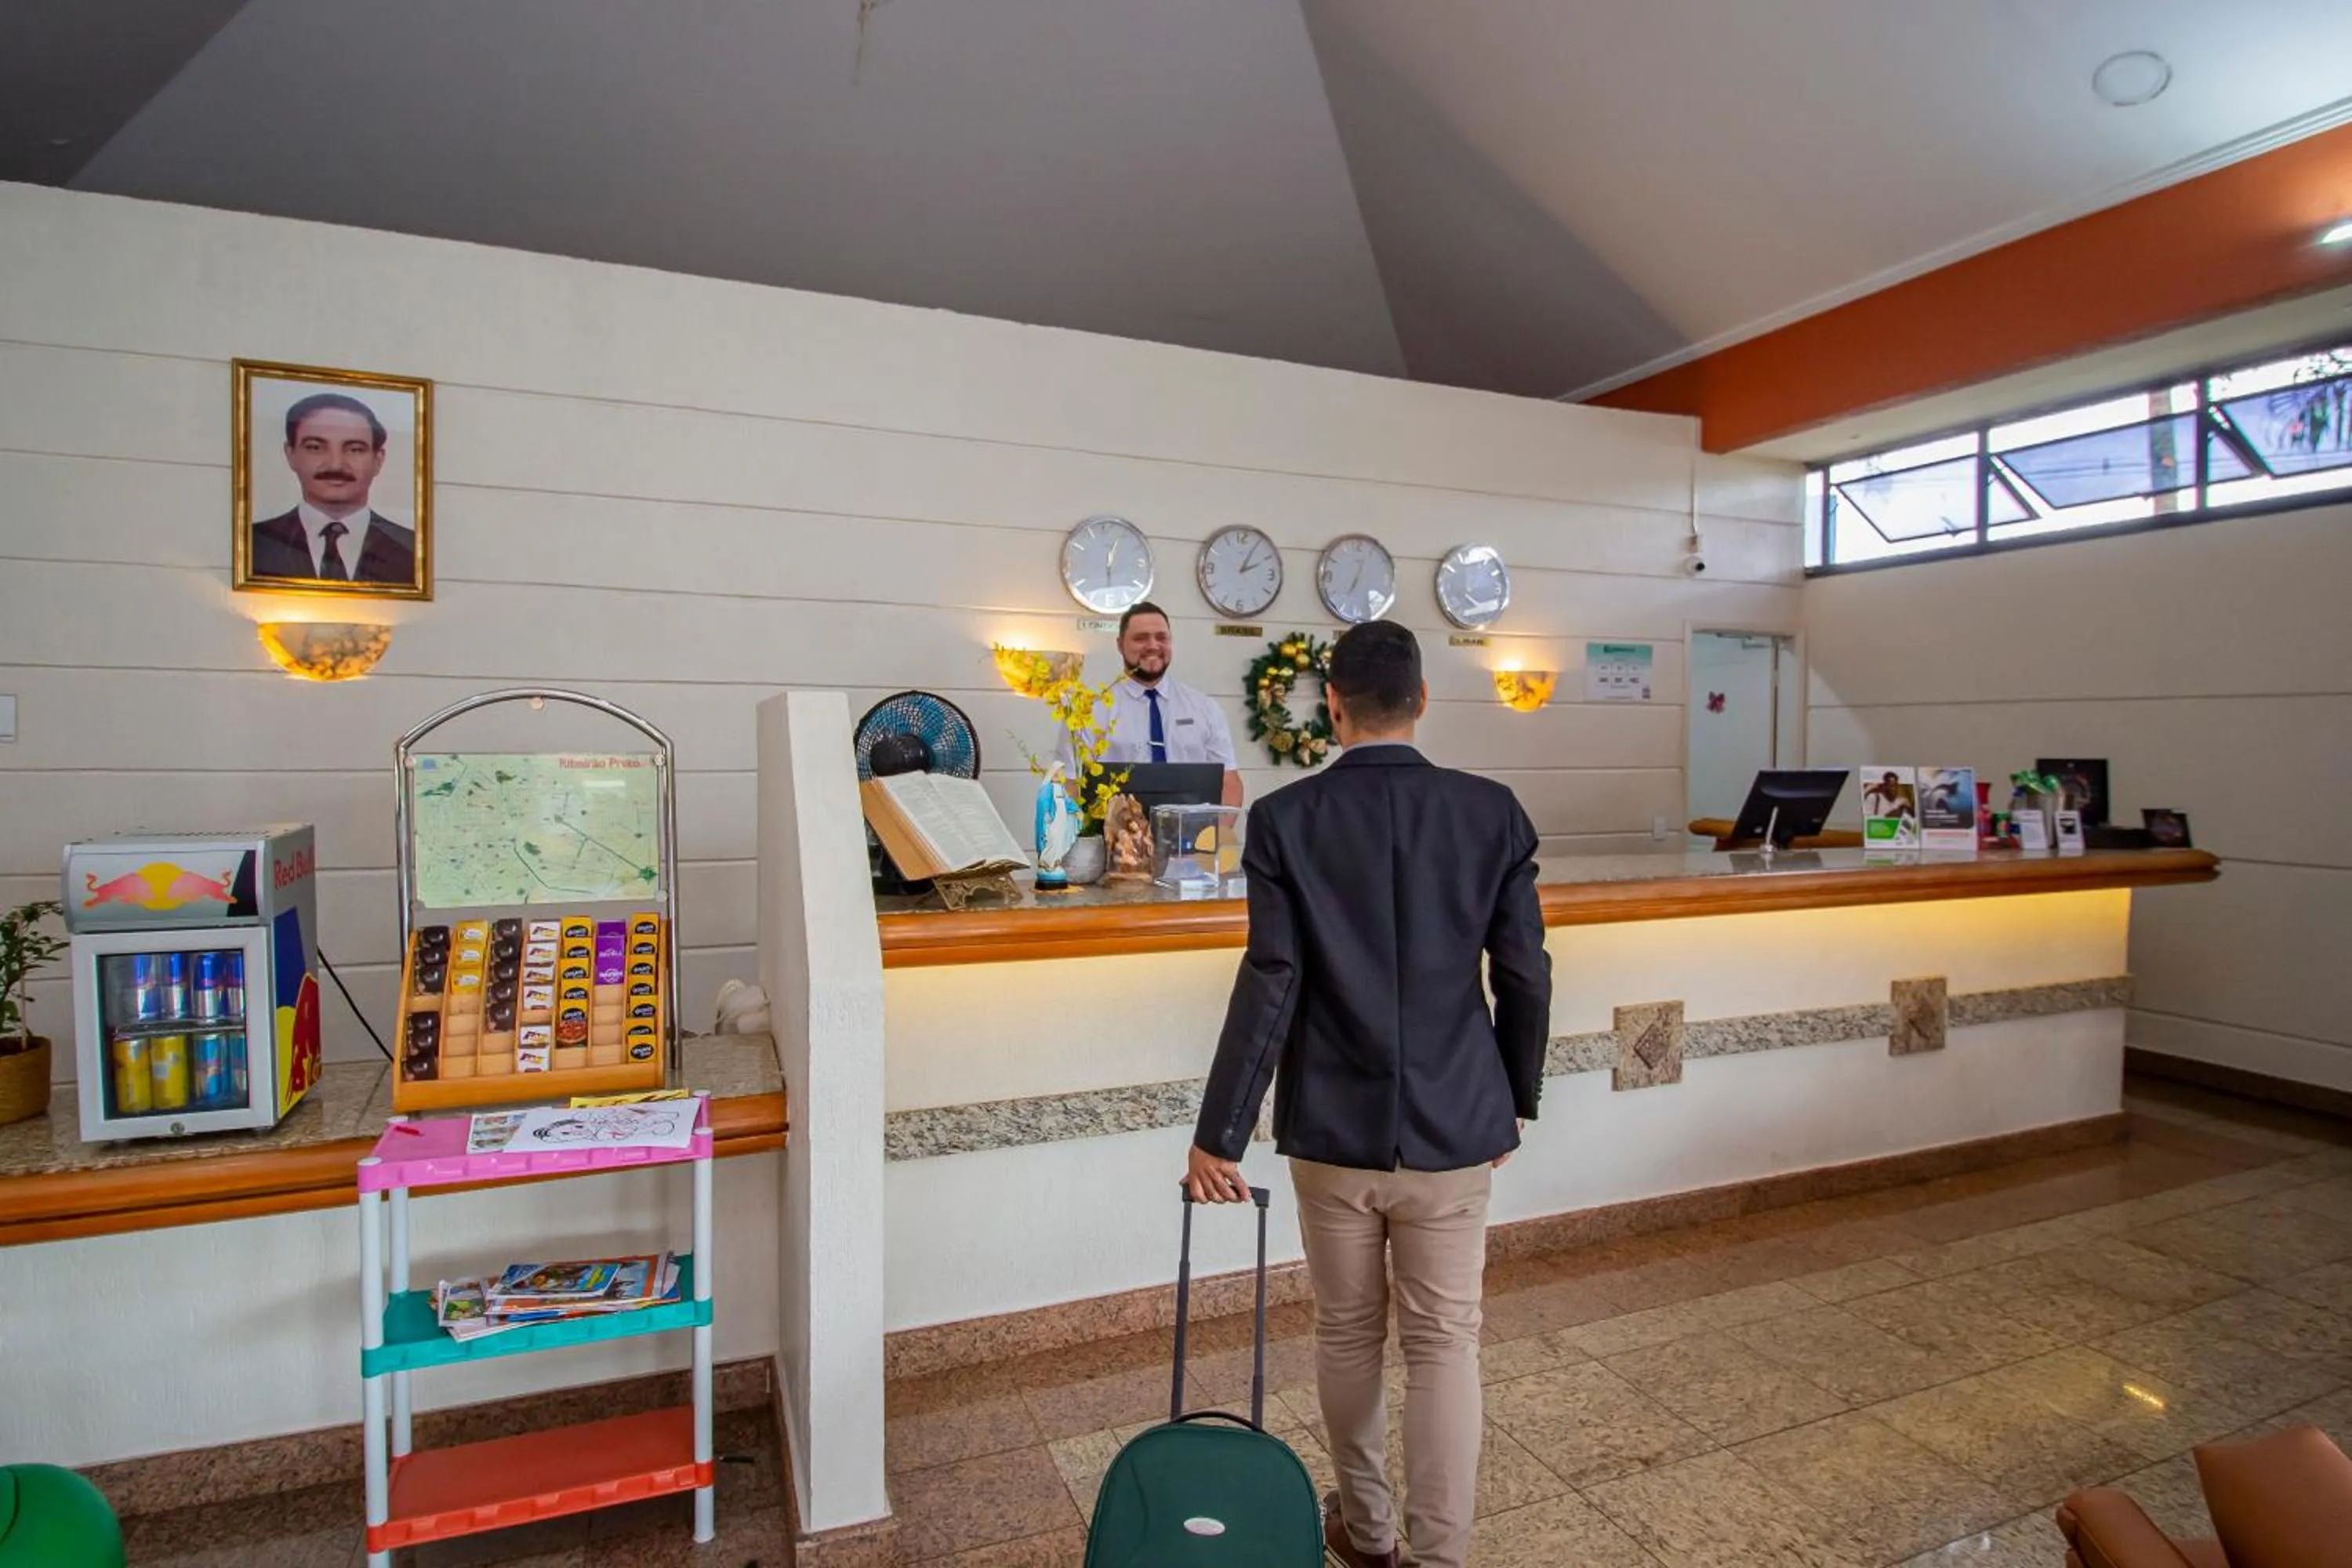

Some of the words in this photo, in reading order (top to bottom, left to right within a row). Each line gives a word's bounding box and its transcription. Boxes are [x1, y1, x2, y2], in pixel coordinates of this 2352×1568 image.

[1236, 532, 1249, 544] 12
[1267, 569, 1276, 581] 3
[1235, 600, 1244, 612] 6
[274, 851, 296, 891] Red
